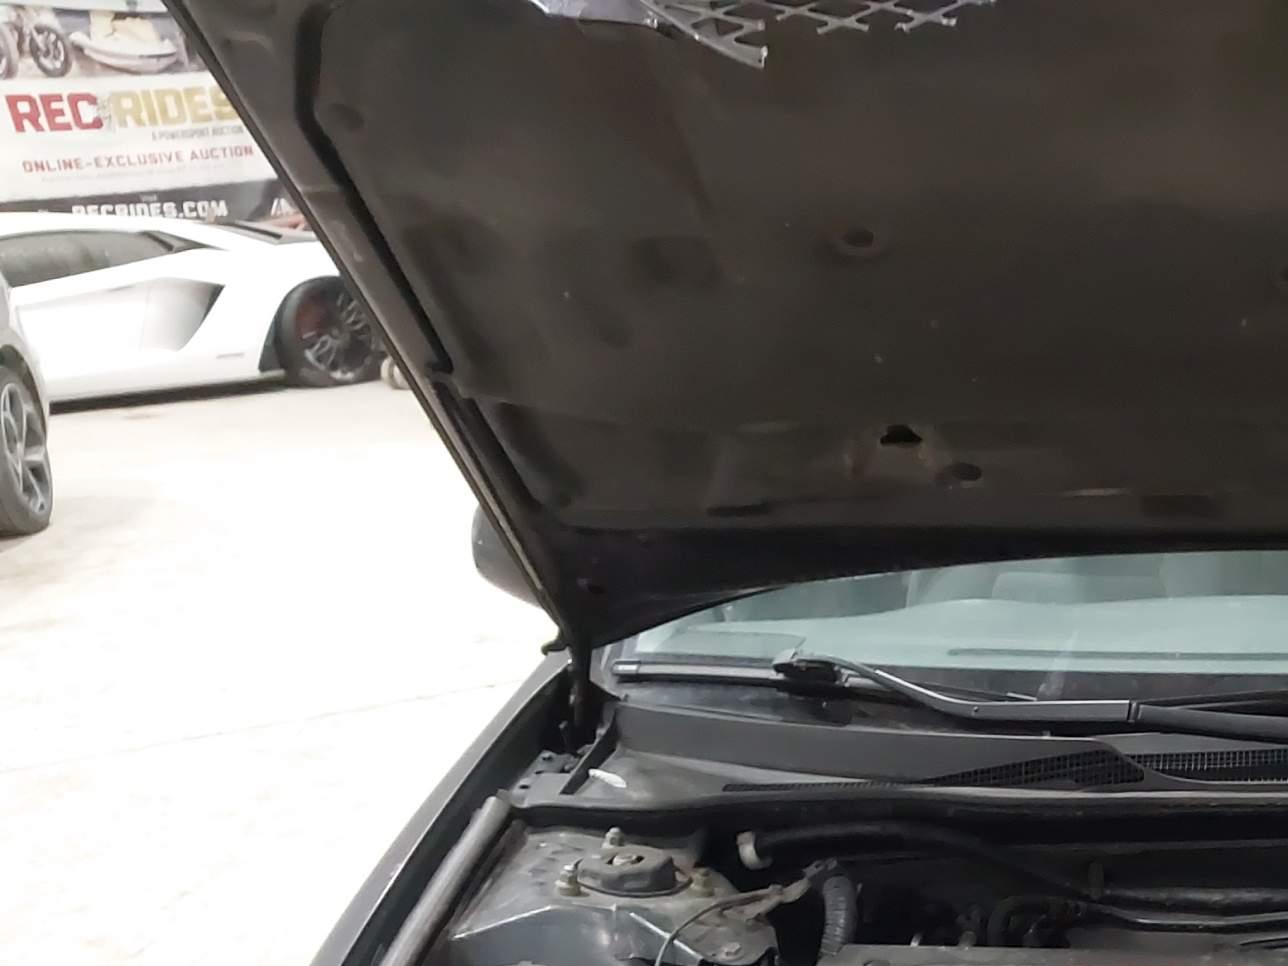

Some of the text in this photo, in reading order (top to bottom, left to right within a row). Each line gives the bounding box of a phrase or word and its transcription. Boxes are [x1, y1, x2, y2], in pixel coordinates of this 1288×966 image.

[5, 92, 104, 132] REC
[22, 144, 254, 174] ONLINE-EXCLUSIVE AUCTION
